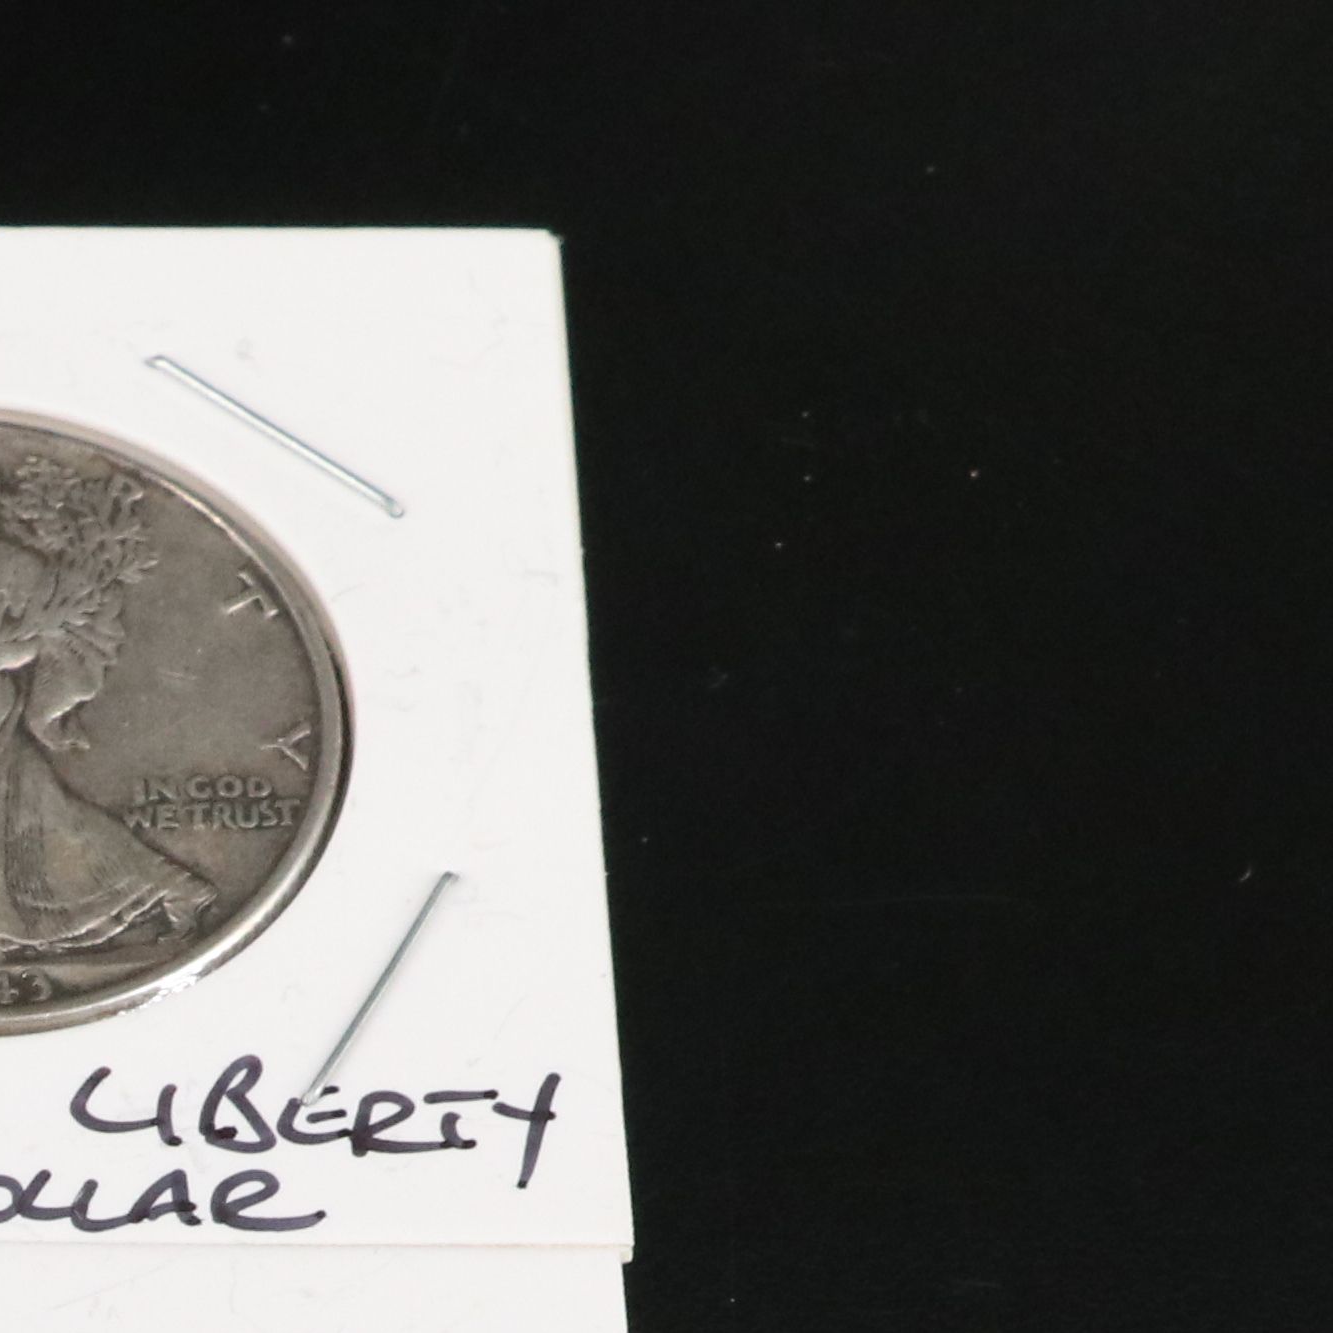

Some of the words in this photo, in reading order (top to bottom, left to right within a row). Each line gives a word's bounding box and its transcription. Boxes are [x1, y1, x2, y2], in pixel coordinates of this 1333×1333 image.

[133, 777, 180, 806] IN
[184, 773, 274, 801] GOD
[122, 803, 182, 831] WE
[186, 798, 301, 832] TRUST
[69, 1055, 562, 1190] LIBERTY
